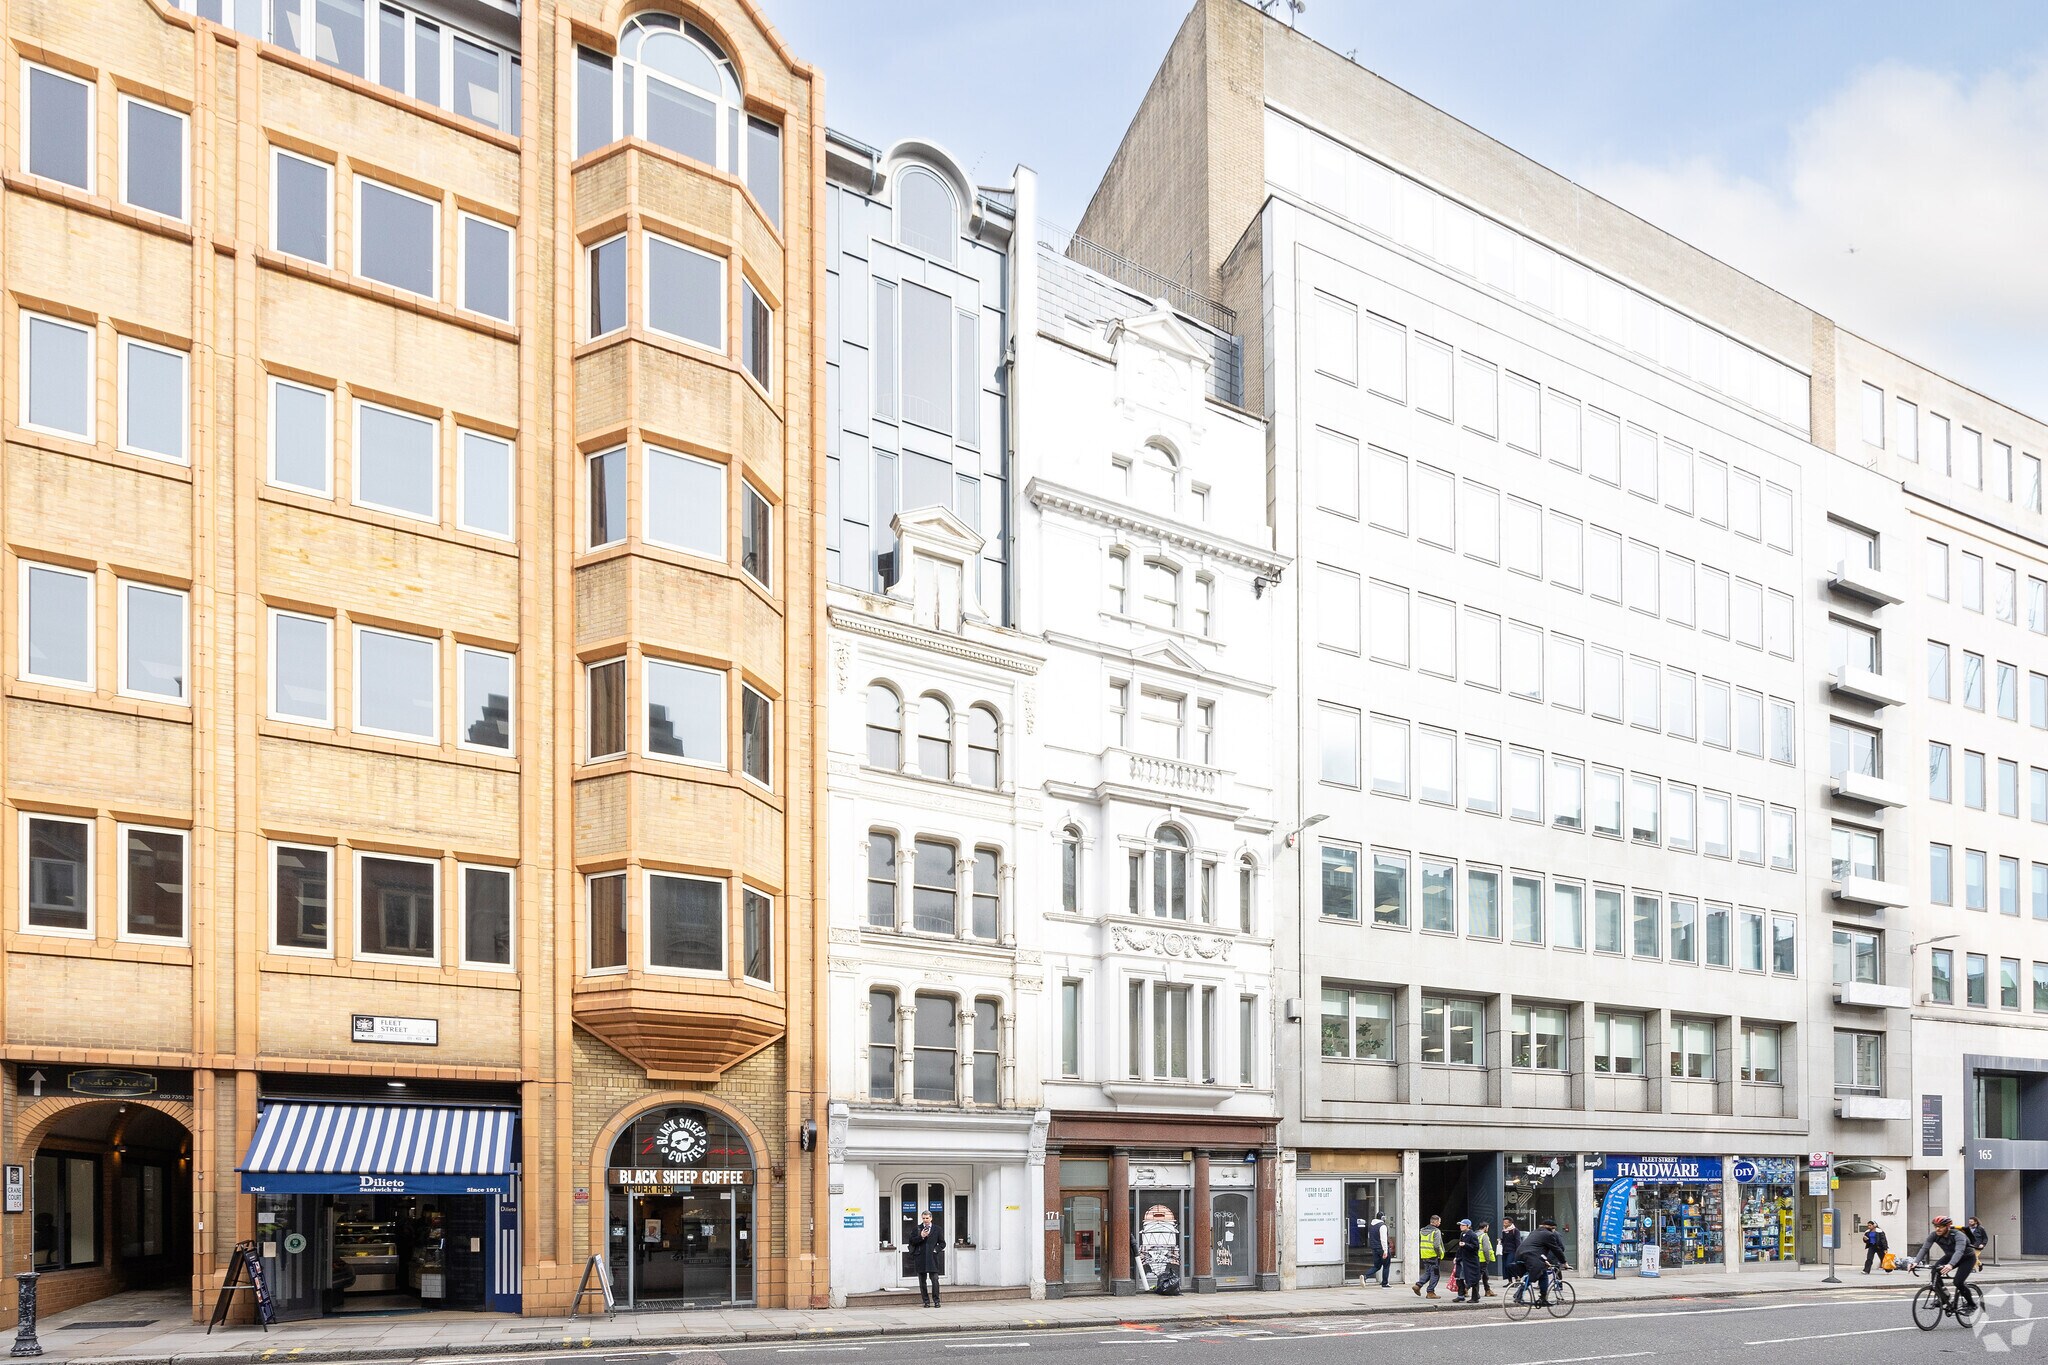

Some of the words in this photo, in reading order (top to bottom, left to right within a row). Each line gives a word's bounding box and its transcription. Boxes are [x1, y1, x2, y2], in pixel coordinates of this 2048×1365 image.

[656, 1119, 678, 1145] BLACK
[679, 1118, 706, 1137] SHEEP
[668, 1144, 706, 1163] COFFEE
[1978, 1149, 1992, 1160] 165
[1527, 1165, 1552, 1177] Surge
[1617, 1163, 1699, 1177] HARDWARE
[1735, 1167, 1754, 1177] DIY
[359, 1175, 405, 1187] Dilieto
[619, 1170, 658, 1184] BLACK
[662, 1170, 698, 1184] SHEEP
[702, 1170, 744, 1185] COFFEE
[656, 1186, 673, 1194] HER
[1879, 1194, 1901, 1216] 167
[1046, 1211, 1059, 1220] 171
